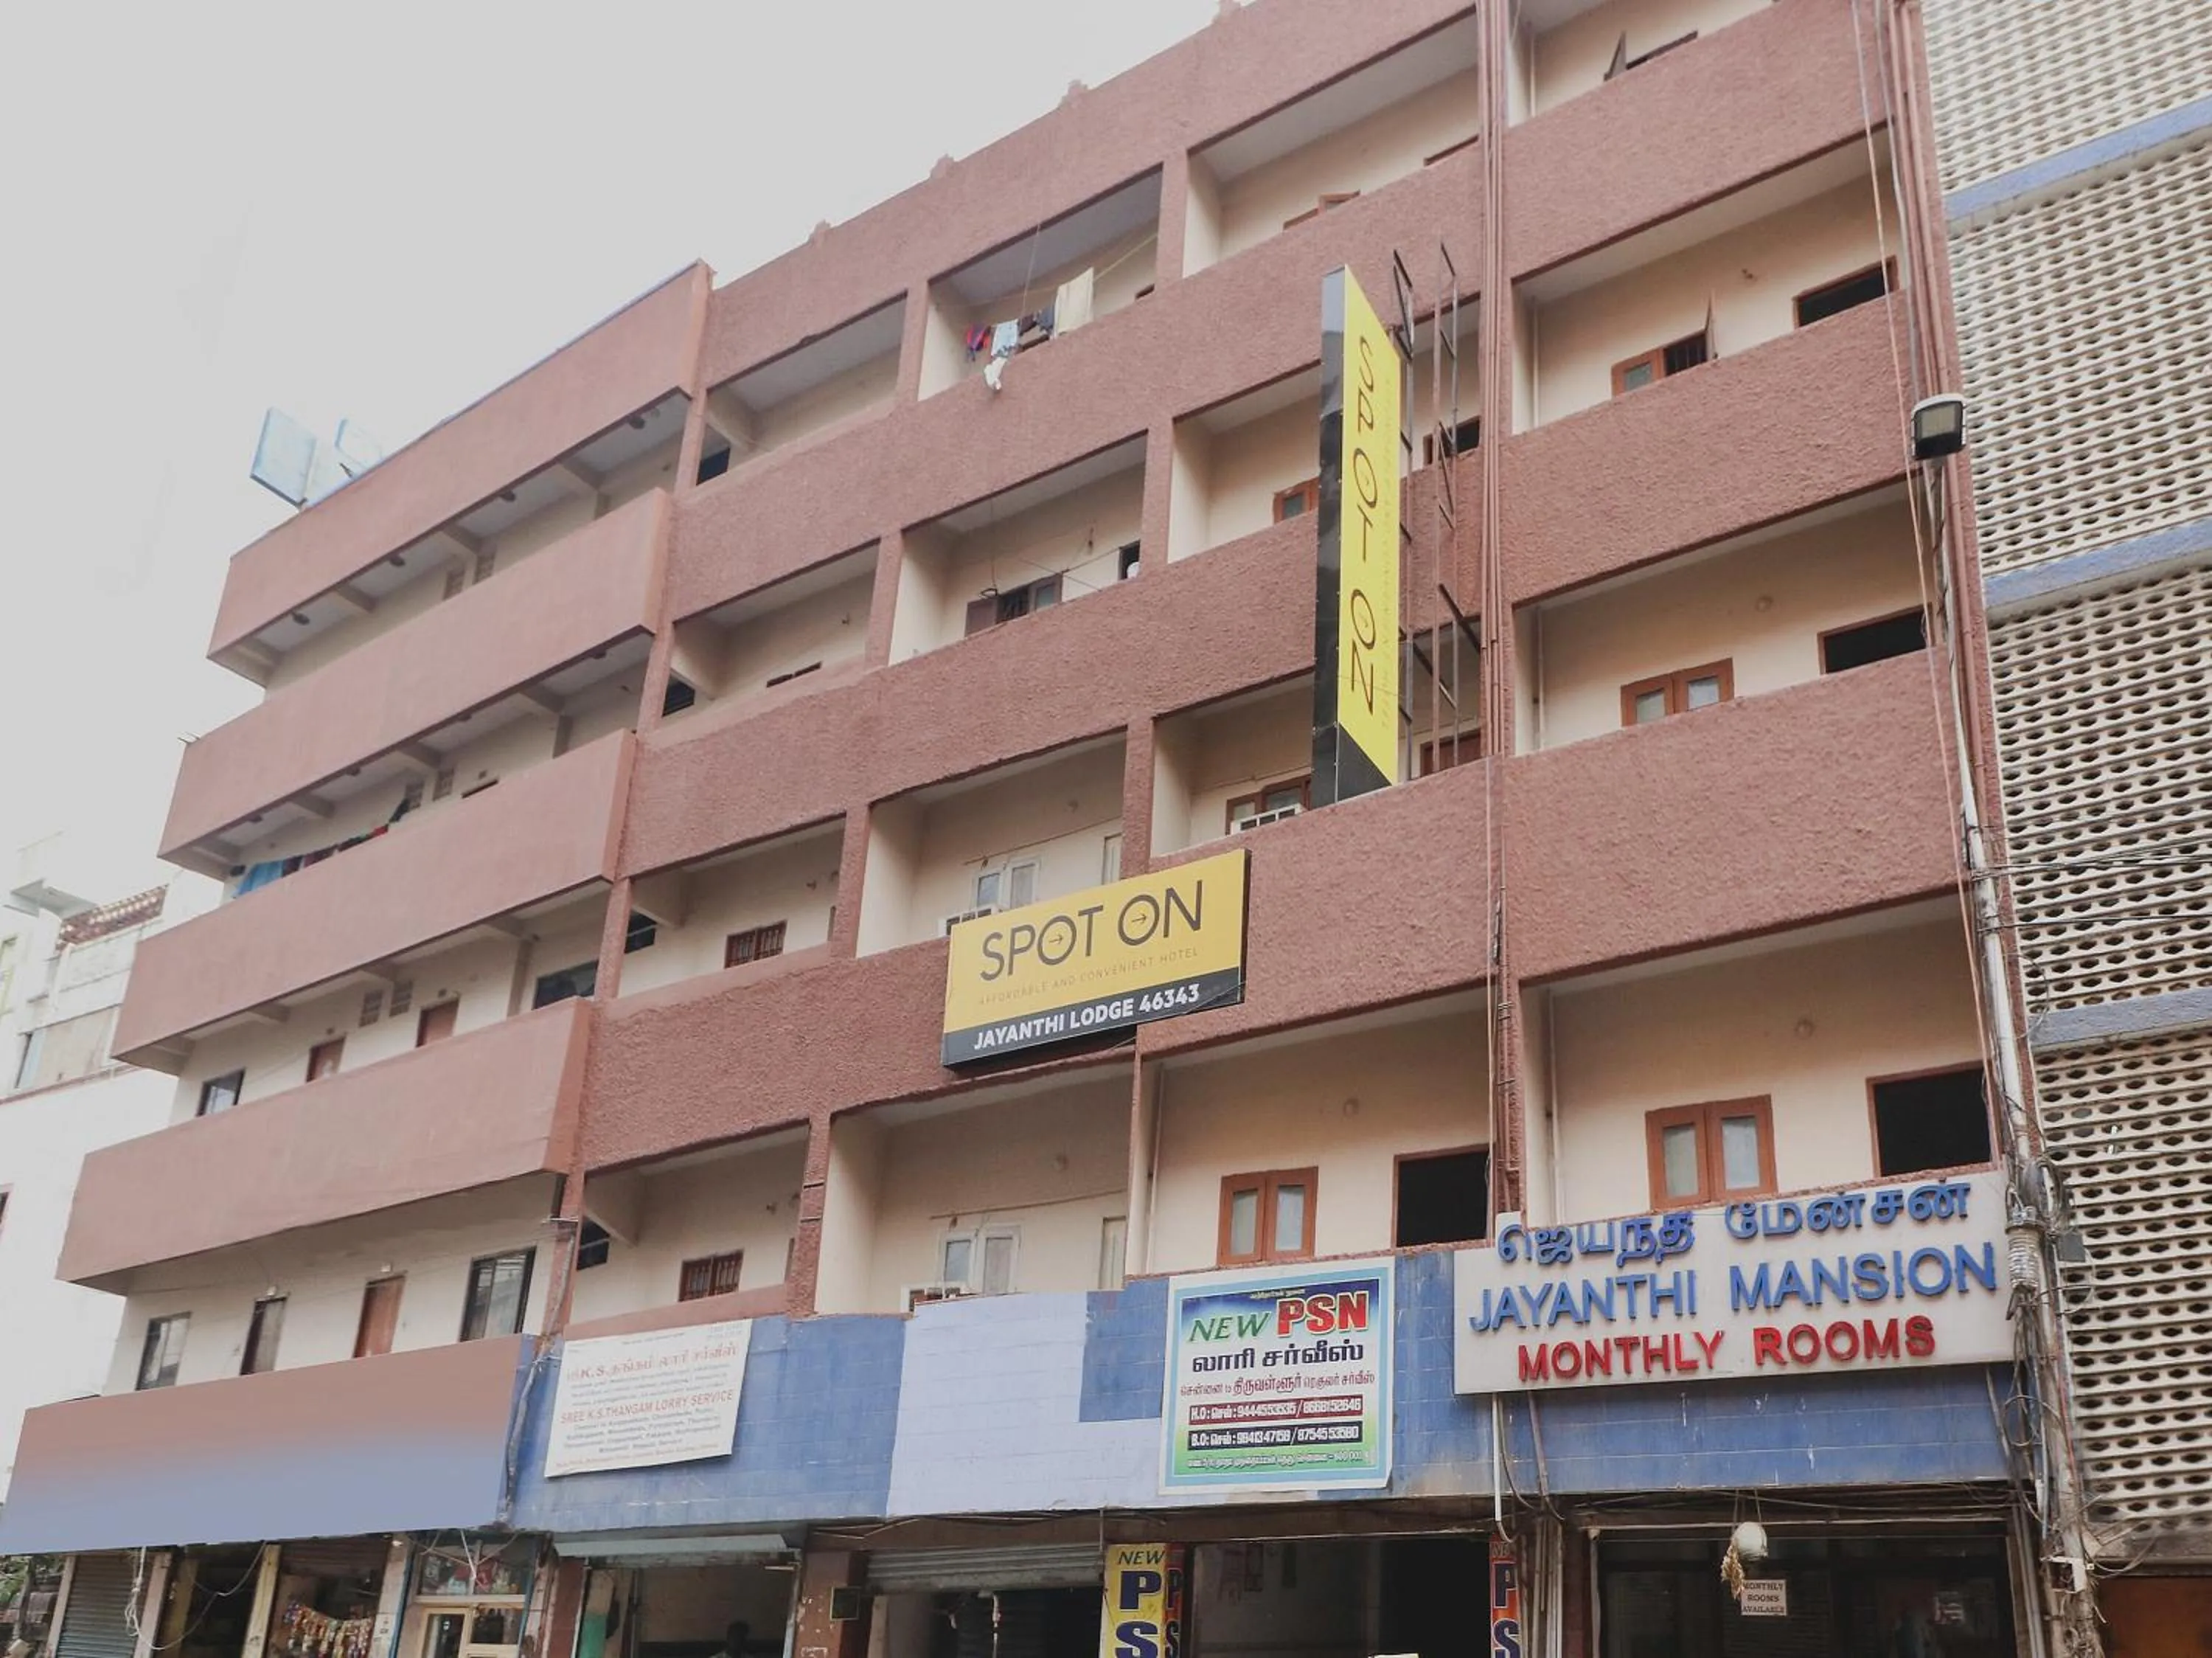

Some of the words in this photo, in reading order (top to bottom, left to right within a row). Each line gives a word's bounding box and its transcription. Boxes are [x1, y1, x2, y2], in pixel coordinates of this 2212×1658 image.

[1352, 336, 1378, 563] SPOT
[1351, 588, 1376, 715] ON
[980, 905, 1104, 981] SPOT
[1118, 880, 1203, 946] ON
[1080, 957, 1154, 982] CONVENIENT
[1160, 947, 1198, 964] HOTEL
[974, 1012, 1065, 1050] JAYANTHI
[1070, 998, 1134, 1029] LODGE
[1138, 983, 1200, 1013] 46343
[1189, 1311, 1272, 1342] NEW
[1276, 1291, 1369, 1337] PSN
[1468, 1269, 1697, 1332] JAYANTHI
[1729, 1242, 1997, 1311] MANSION
[1192, 1347, 1255, 1373] லாரி
[1262, 1339, 1364, 1367] சர்வீஸ்
[1517, 1329, 1725, 1382] MONTHLY
[1753, 1315, 1935, 1365] ROOMS
[1118, 1550, 1166, 1565] NEW
[1747, 1594, 1780, 1602] ROOMS
